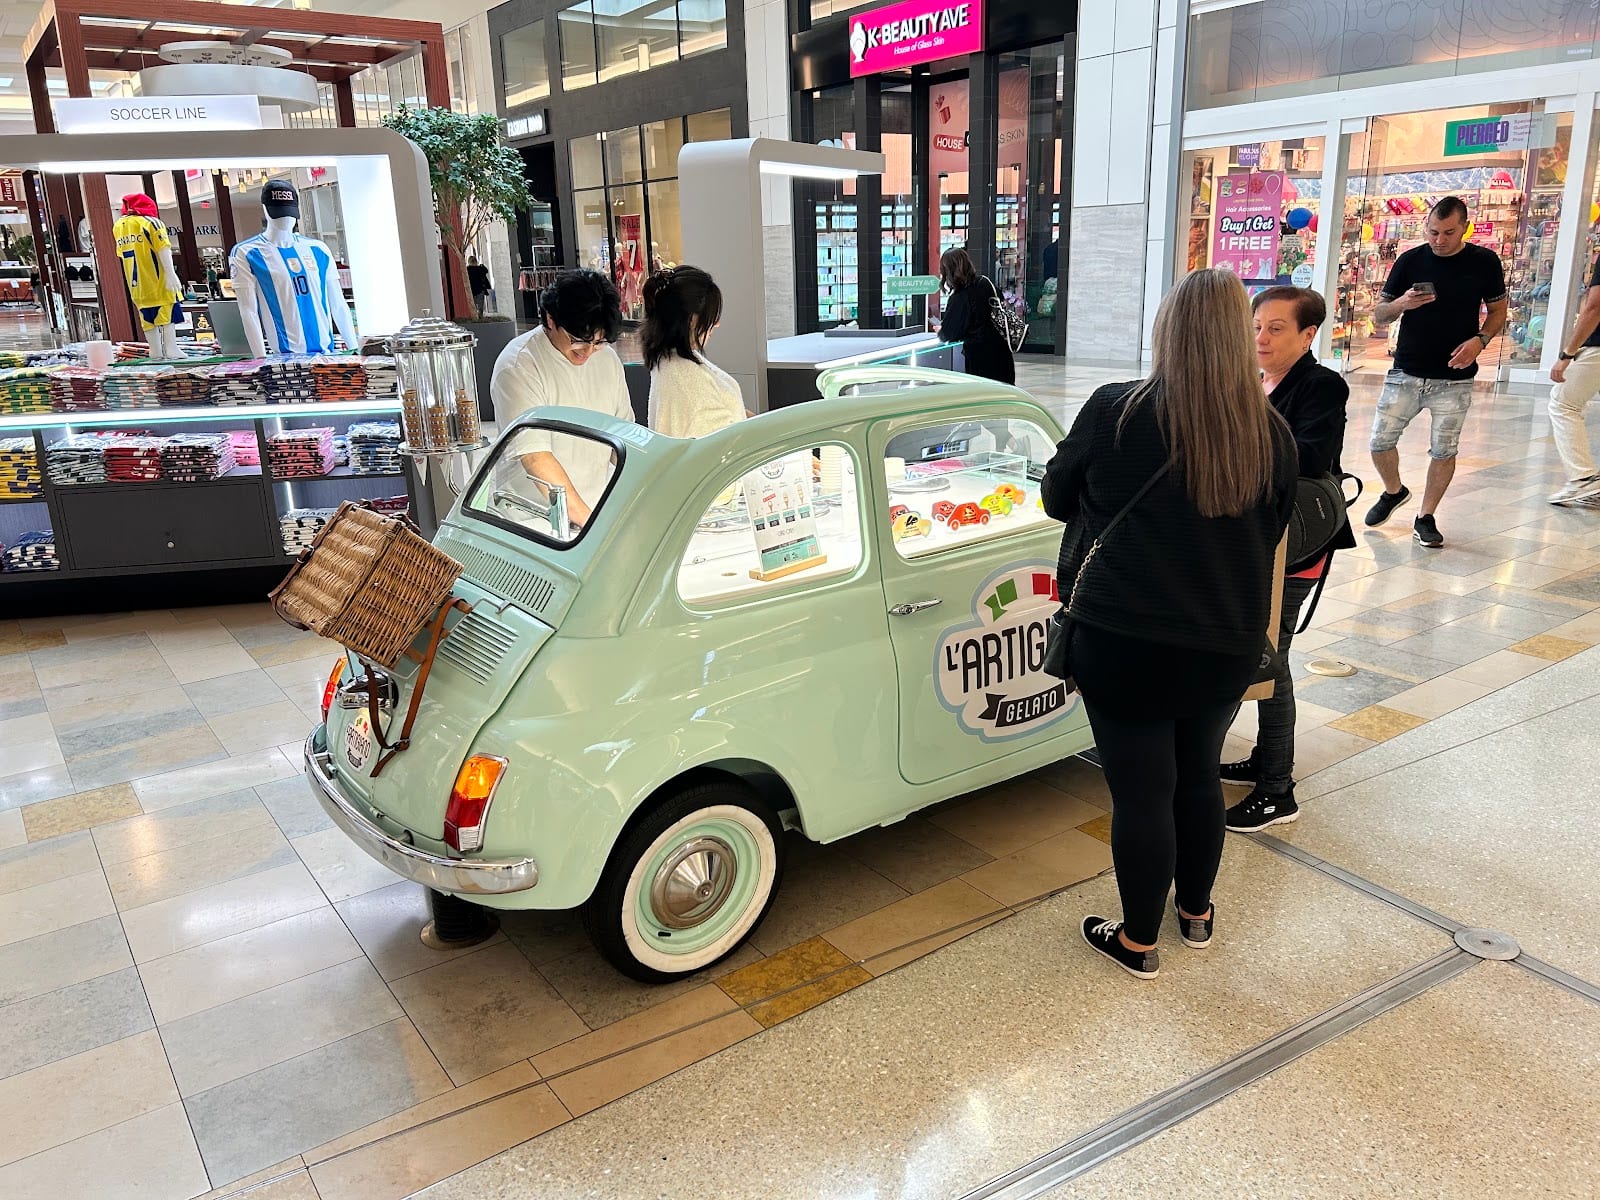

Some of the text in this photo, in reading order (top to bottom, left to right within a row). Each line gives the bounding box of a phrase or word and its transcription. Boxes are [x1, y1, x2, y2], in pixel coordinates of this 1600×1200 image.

[868, 3, 969, 48] K-BEAUTY AVE
[894, 45, 911, 55] House
[918, 40, 932, 50] Glass
[933, 37, 945, 46] Skin
[110, 107, 207, 120] SOCCER LINE
[1007, 128, 1025, 142] SKIN
[1457, 121, 1509, 146] PIERCED
[936, 136, 963, 149] HOUSE
[271, 190, 293, 200] MESSI
[1238, 205, 1271, 213] Accessories
[1221, 216, 1274, 233] Buy 1 Get
[1220, 236, 1226, 250] 1
[122, 250, 138, 287] 7
[292, 275, 309, 296] 10
[1006, 689, 1057, 723] GELATO
